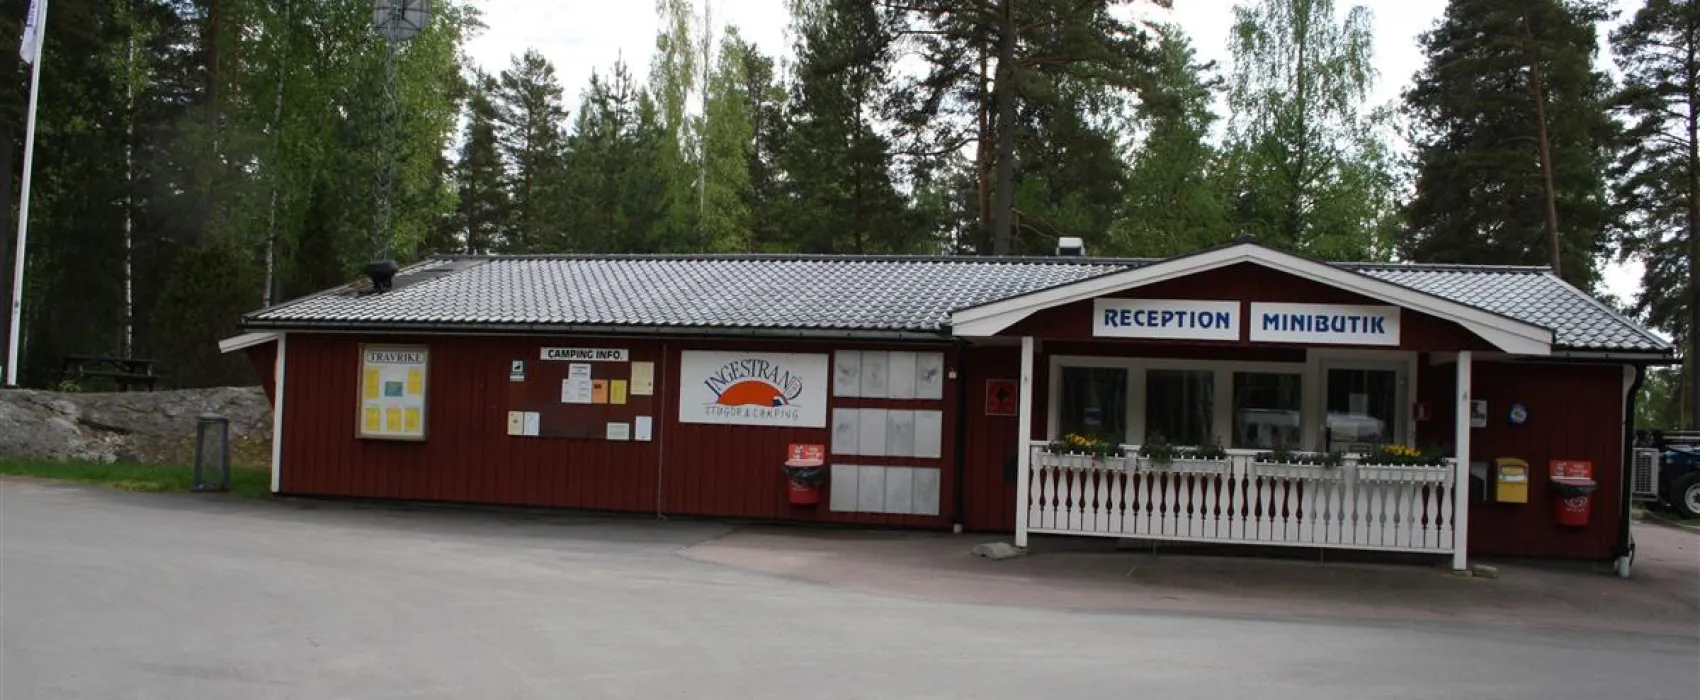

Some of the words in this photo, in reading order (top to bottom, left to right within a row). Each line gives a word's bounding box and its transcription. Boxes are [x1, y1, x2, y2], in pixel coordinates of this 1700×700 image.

[1104, 309, 1230, 329] RECEPTION
[1263, 313, 1385, 334] MINIBUTIK
[371, 352, 420, 362] TRAVRIKE
[548, 349, 593, 359] CAMPING
[596, 350, 623, 360] INFO.
[704, 359, 803, 400] INGESTRAND
[753, 408, 799, 421] CAMPING
